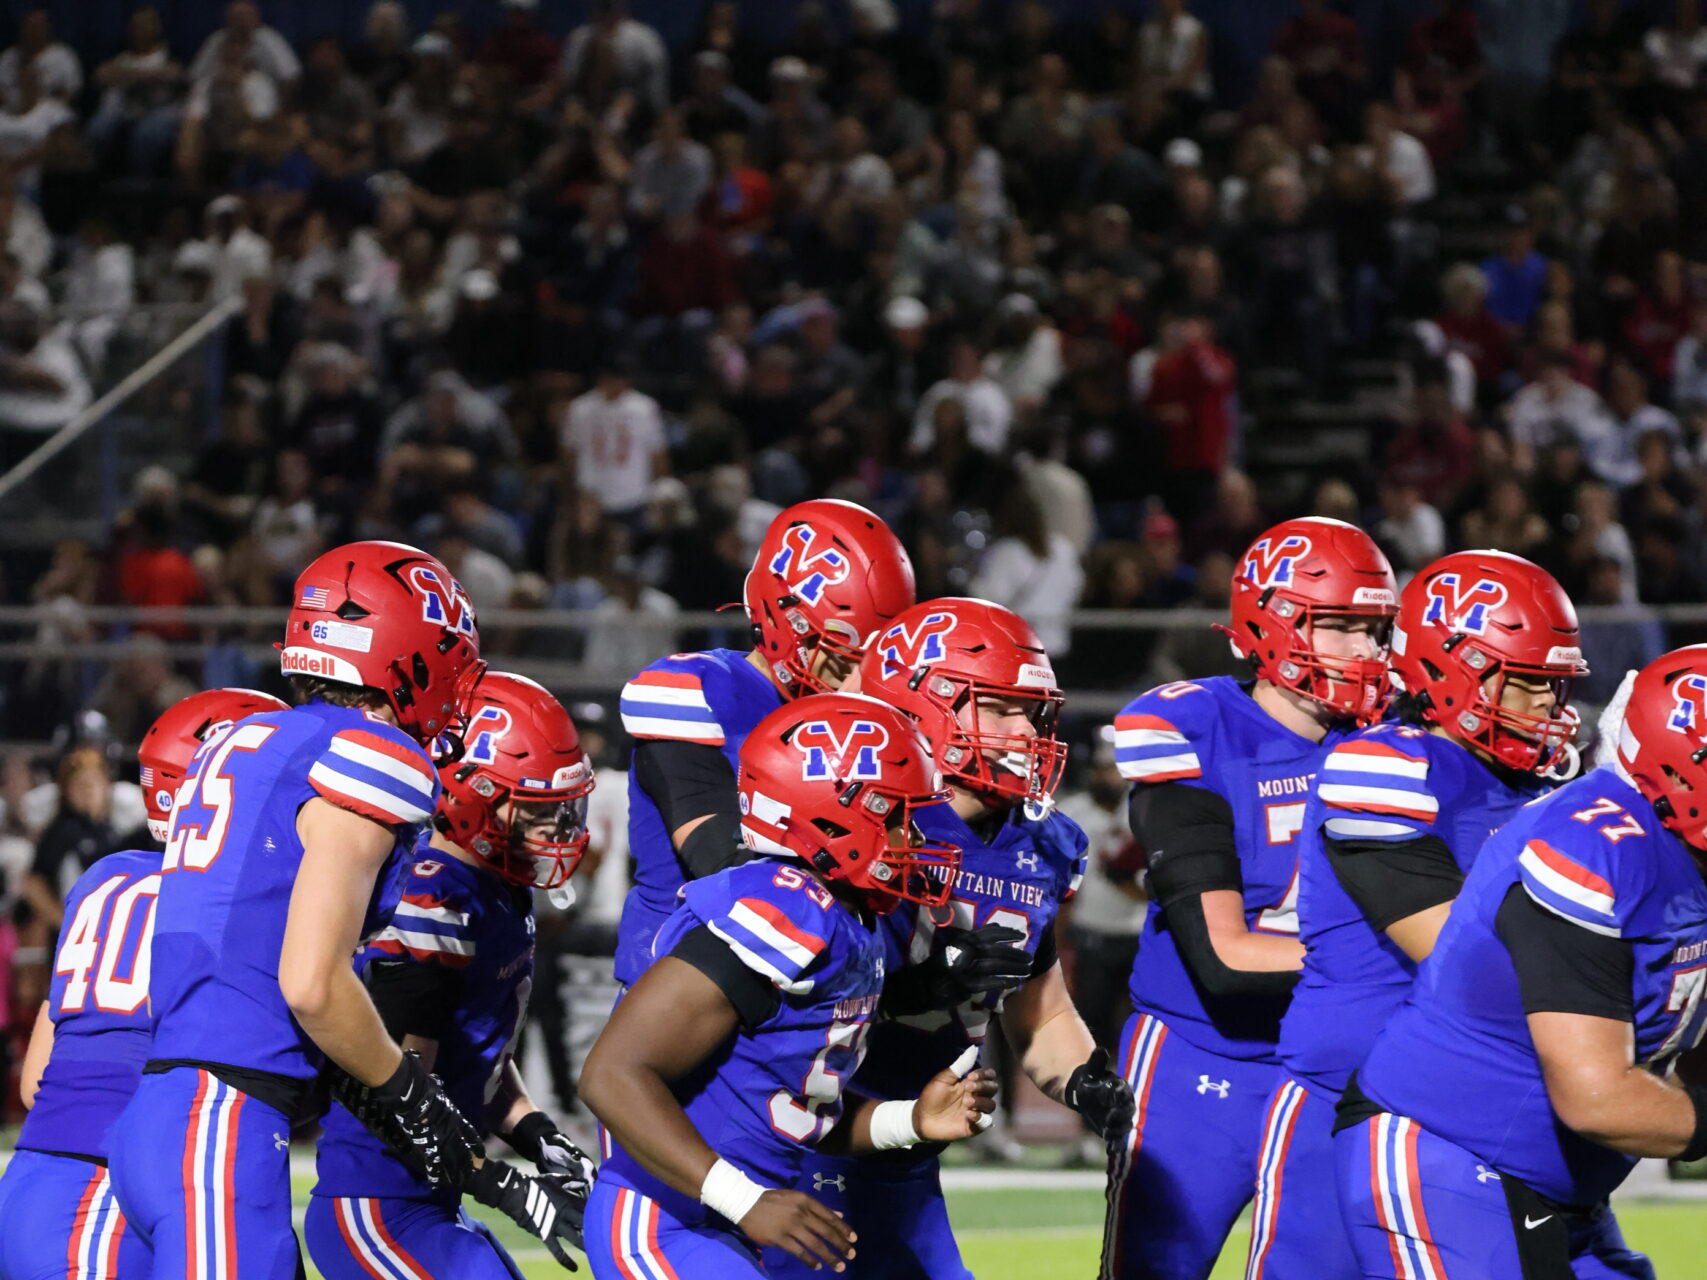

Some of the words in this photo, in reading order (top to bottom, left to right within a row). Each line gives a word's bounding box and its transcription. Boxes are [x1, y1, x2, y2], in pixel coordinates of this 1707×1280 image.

[312, 624, 329, 640] 25
[282, 651, 336, 677] Riddell
[157, 795, 172, 808] 40
[160, 721, 281, 873] 25
[1570, 796, 1648, 845] 77
[771, 864, 836, 913] 53
[927, 864, 1005, 898] OUNTAIN
[1010, 881, 1045, 908] VIEW
[55, 872, 164, 1016] 40
